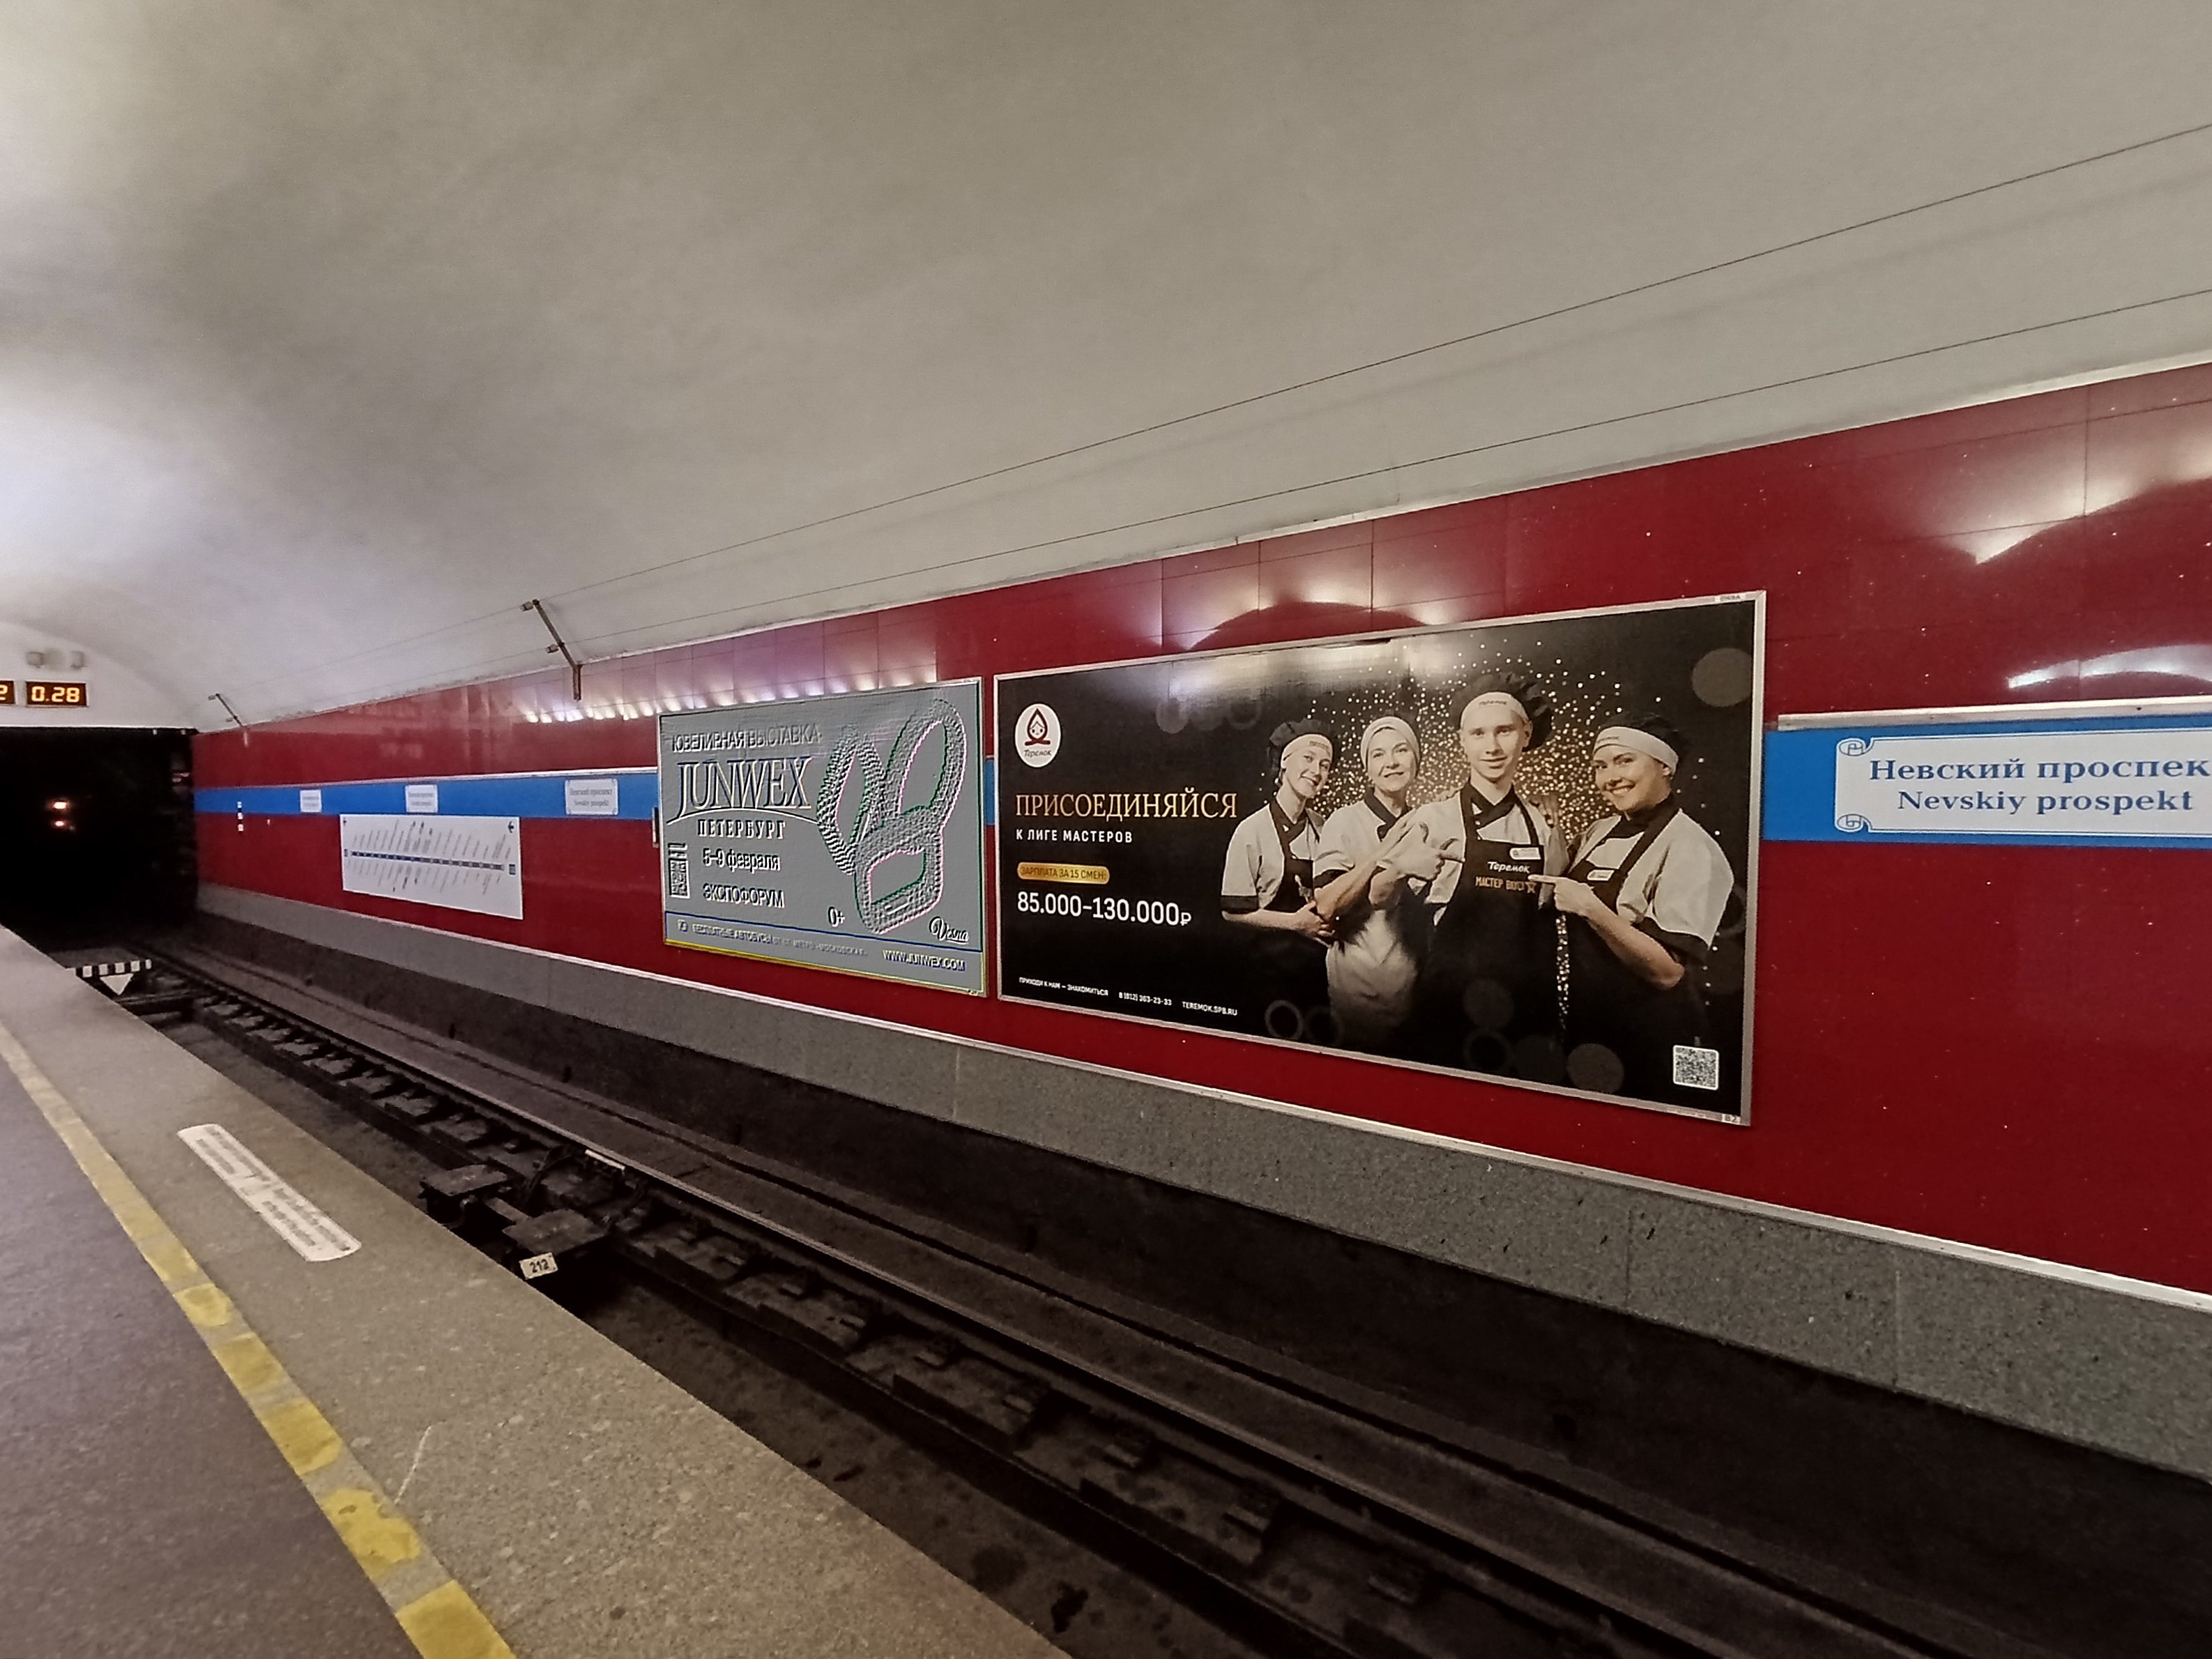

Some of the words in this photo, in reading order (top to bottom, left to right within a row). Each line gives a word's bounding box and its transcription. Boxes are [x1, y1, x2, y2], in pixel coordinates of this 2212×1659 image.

[672, 731, 746, 753] ЮВЕЛИРНАЯ
[747, 723, 821, 749] ВЫСТАВКА
[1870, 758, 2026, 781] Невский
[677, 756, 813, 817] JUNWEX
[1015, 787, 1237, 823] ПРИСОЕДИНЯЙСЯ
[1898, 790, 2027, 816] Nevskiy
[2036, 790, 2193, 816] prospekt
[697, 818, 786, 840] ПЕТЕРБУРГ
[1016, 829, 1024, 840] К
[1027, 829, 1058, 841] ЛИГЕ
[1062, 830, 1133, 843] МАСТЕРОВ
[726, 848, 781, 874] февраля
[1020, 866, 1058, 878] ЗАРПЛАТА
[1059, 869, 1069, 878] ЗА
[1070, 869, 1079, 878] 15
[1487, 861, 1530, 874] Теремок
[1475, 876, 1504, 889] МАСТЕР
[703, 882, 786, 908] ЭКСПОФОРУМ
[883, 949, 966, 971] WWW.JUNWEX.COM
[1019, 977, 1044, 986] ПРИХОДИ
[1067, 984, 1108, 996] ЗНАКОМИТЬСЯ
[1182, 1001, 1237, 1016] TEREMOK.SPB.RU
[529, 1258, 549, 1274] 212
